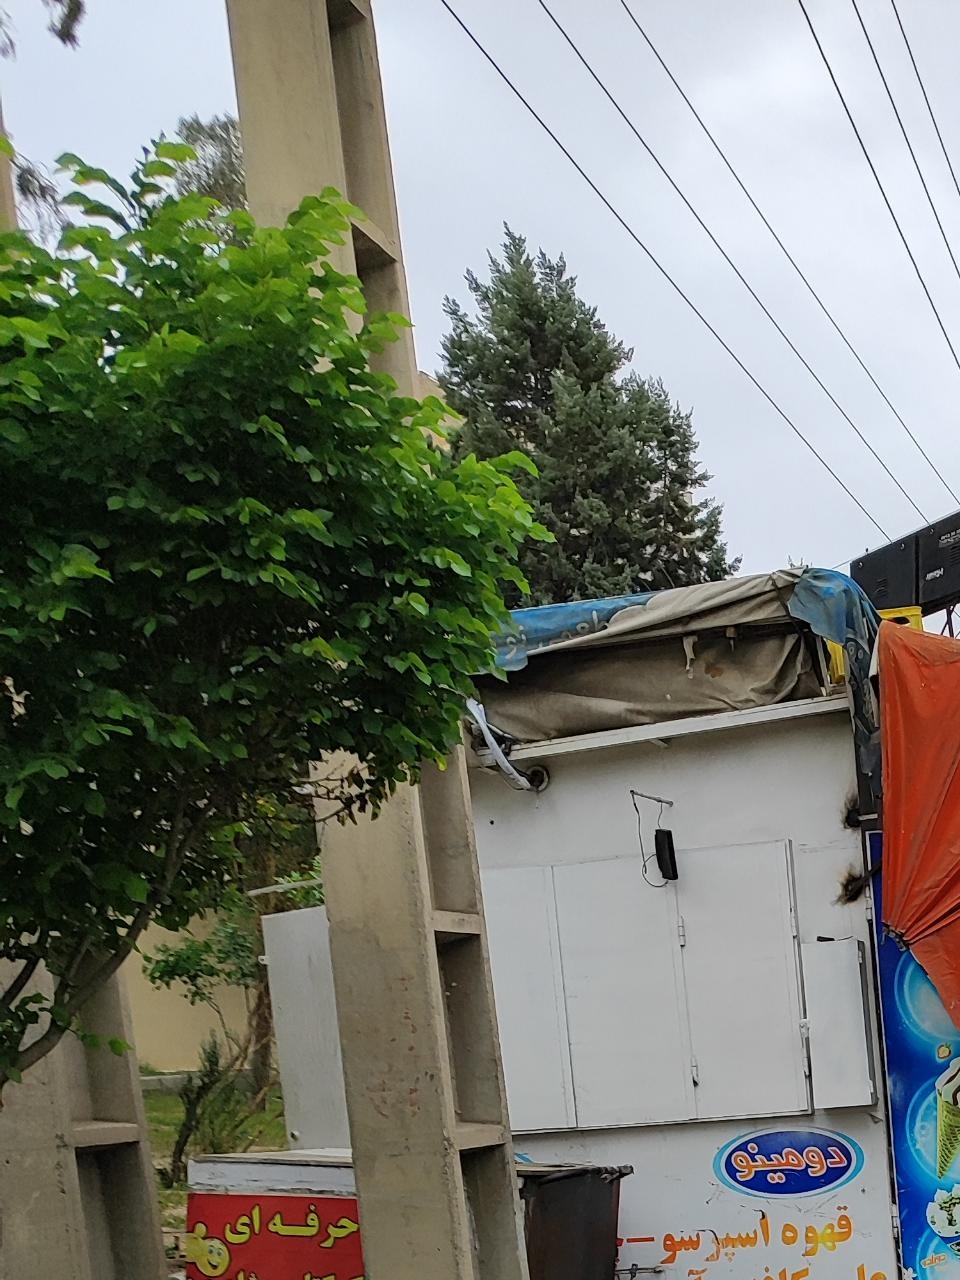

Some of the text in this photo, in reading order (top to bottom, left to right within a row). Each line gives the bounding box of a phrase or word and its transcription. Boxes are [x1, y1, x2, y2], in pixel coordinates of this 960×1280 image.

[730, 1142, 848, 1184] دومینو
[661, 1210, 770, 1264] اسپرسو
[780, 1205, 853, 1256] قهوه
